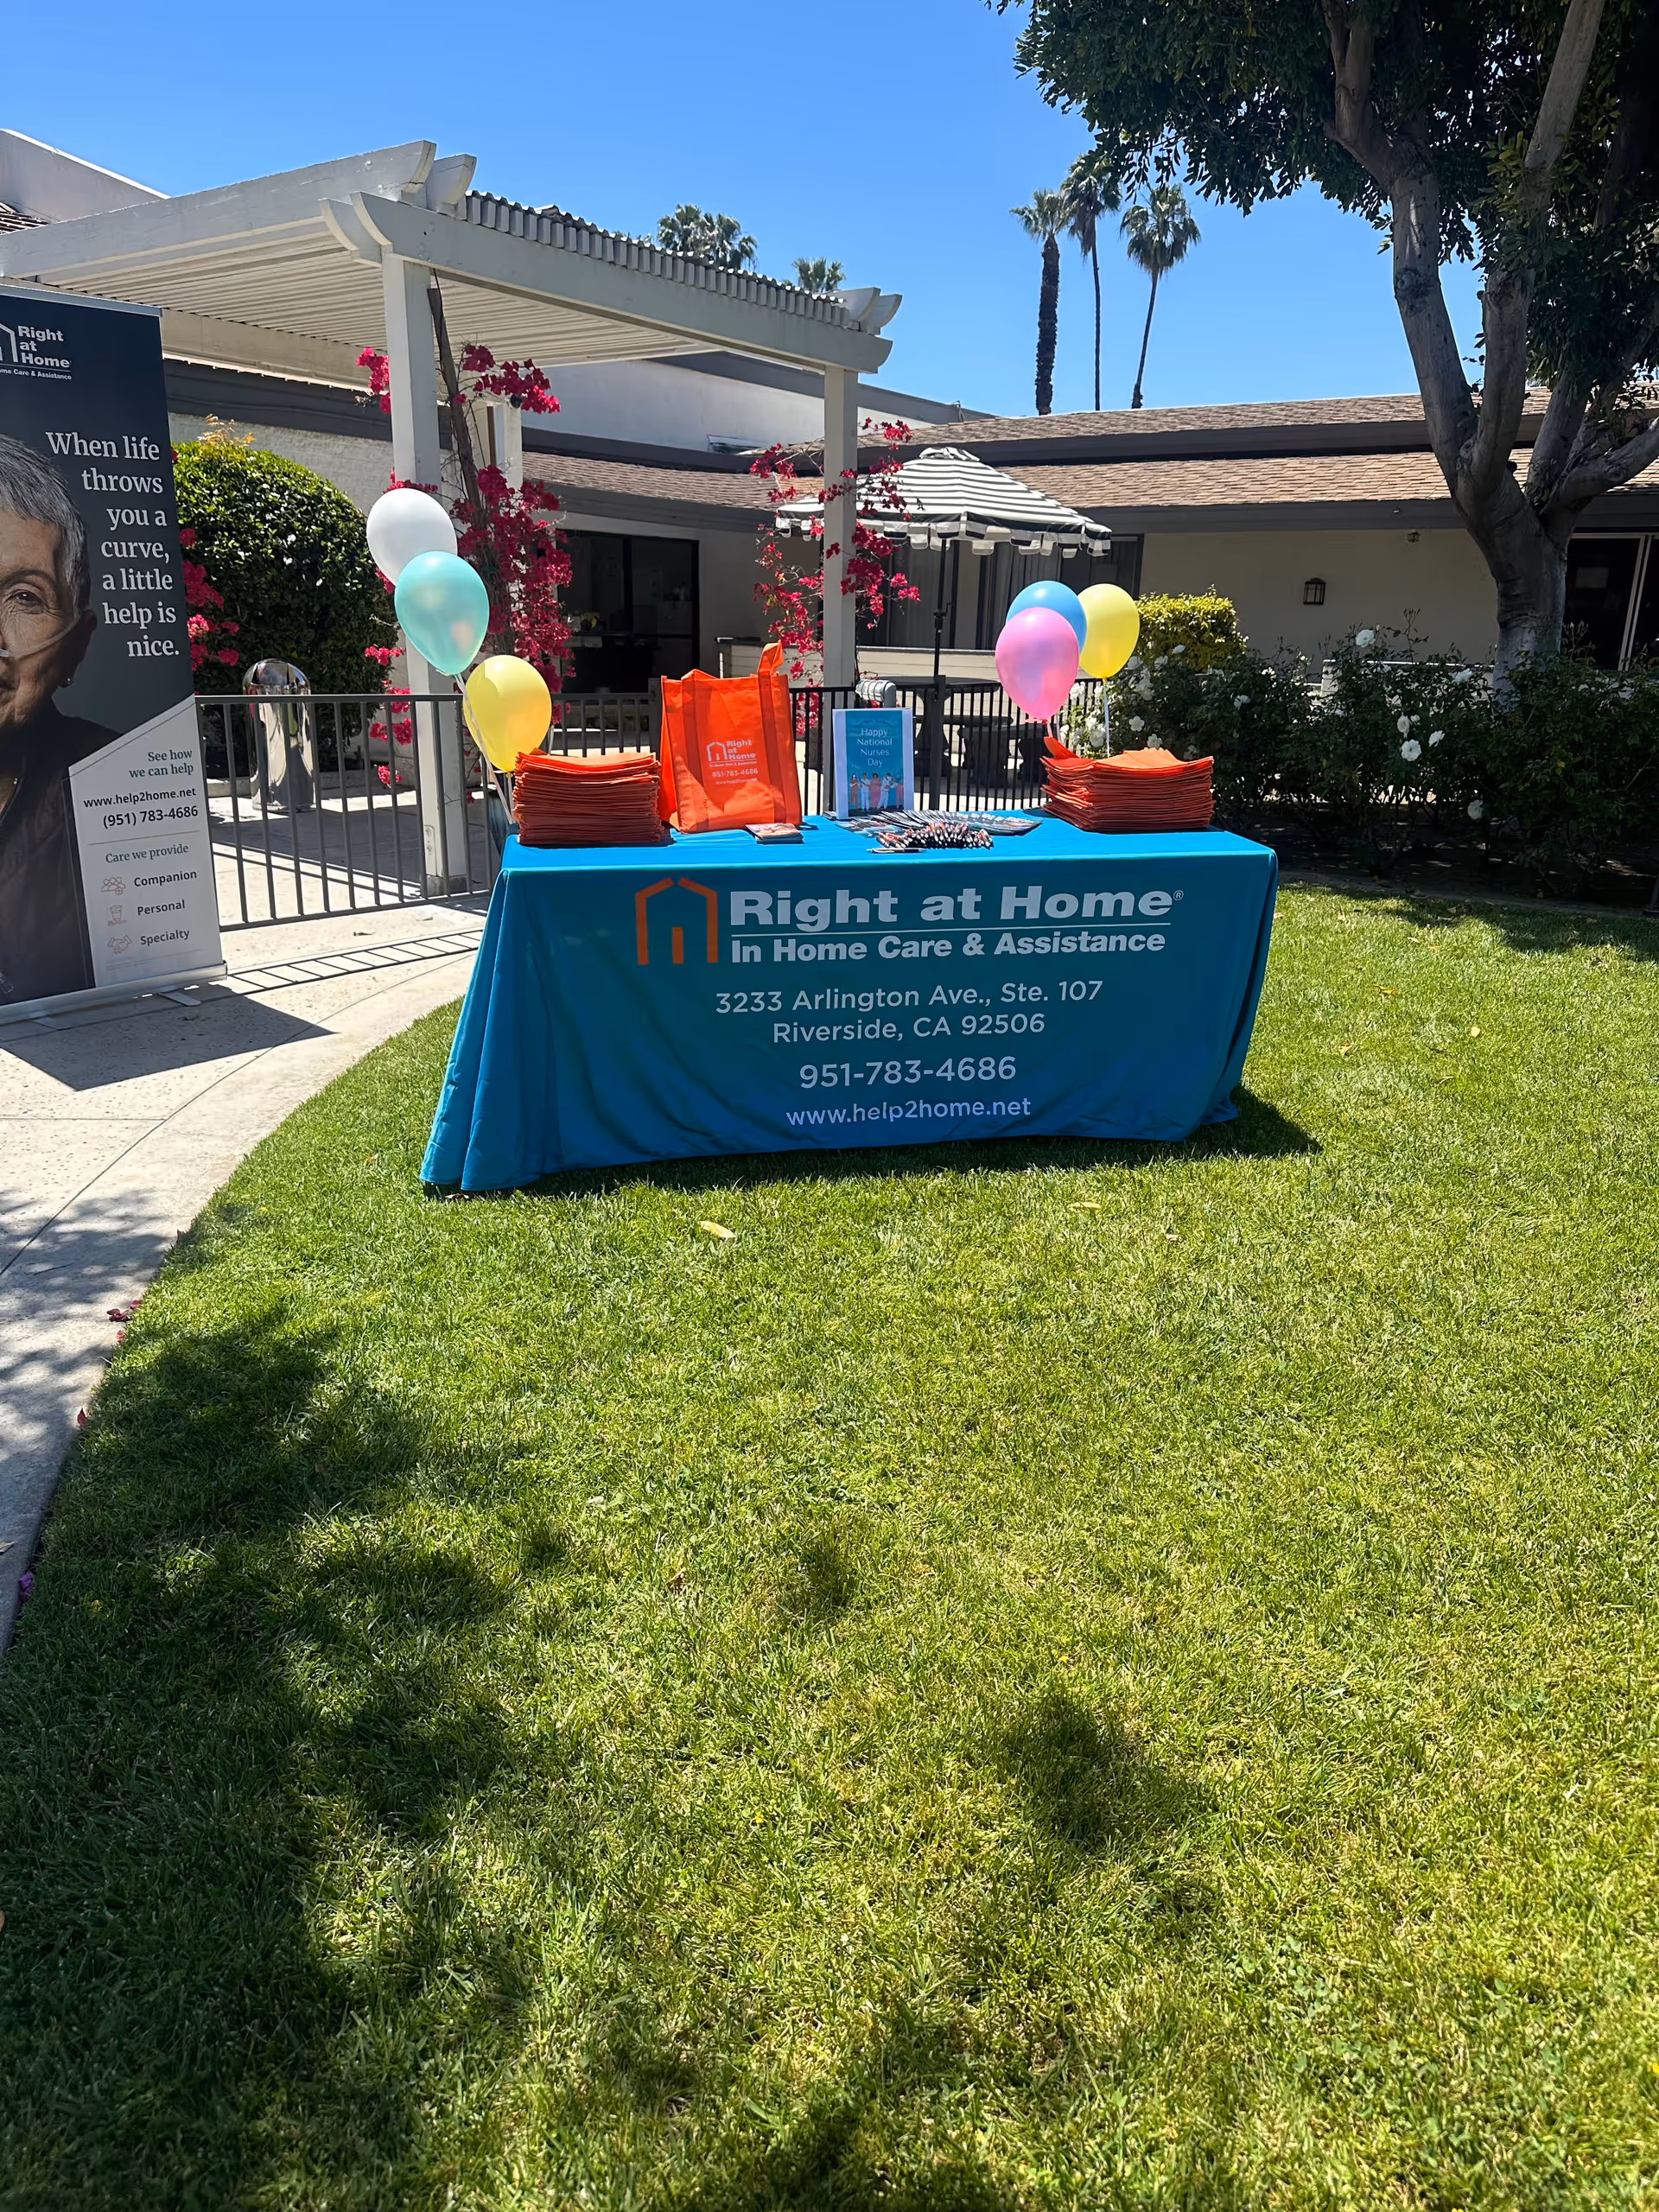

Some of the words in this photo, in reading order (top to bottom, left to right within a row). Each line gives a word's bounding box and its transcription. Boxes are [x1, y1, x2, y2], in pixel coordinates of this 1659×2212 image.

[17, 325, 64, 341] Right
[20, 340, 37, 352] at
[21, 352, 70, 368] Home
[37, 372, 72, 380] Assistance
[46, 431, 118, 458] When
[123, 435, 160, 461] life
[81, 467, 163, 493] throws
[106, 508, 149, 531] you
[155, 510, 167, 526] a
[101, 541, 170, 563] curve,
[102, 574, 116, 590] a
[119, 568, 174, 590] little
[102, 602, 152, 629] help
[157, 601, 176, 623] is
[127, 634, 180, 657] nice.
[861, 728, 888, 737] Happy
[148, 751, 167, 761] See
[169, 749, 193, 760] how
[868, 758, 883, 768] Day
[129, 768, 145, 778] we
[148, 766, 168, 777] can
[170, 762, 194, 775] help
[84, 788, 196, 807] www.help2home.net
[104, 811, 137, 830] (951)
[139, 805, 199, 823] 783-4686
[105, 853, 130, 863] Care
[131, 850, 147, 861] we
[149, 843, 189, 860] provide
[134, 870, 197, 887] Companion
[137, 899, 185, 916] Personal
[730, 889, 899, 932] Right
[920, 887, 982, 921] at
[140, 930, 190, 946] Specialty
[731, 940, 762, 963] In
[773, 938, 868, 962] Home
[878, 935, 952, 958] Care
[963, 932, 985, 956] &
[994, 931, 1166, 955] Assistance
[715, 991, 783, 1014] 3233
[791, 988, 919, 1012] Arlington
[928, 985, 991, 1006] Ave.,
[1000, 982, 1048, 1002] Ste.
[1058, 980, 1103, 1001] 107
[773, 1019, 904, 1043] Riverside,
[912, 1016, 951, 1037] CA
[961, 1013, 1046, 1035] 92506
[798, 1056, 1017, 1089] 951-783-4686
[785, 1097, 1032, 1126] www.help2home.net
